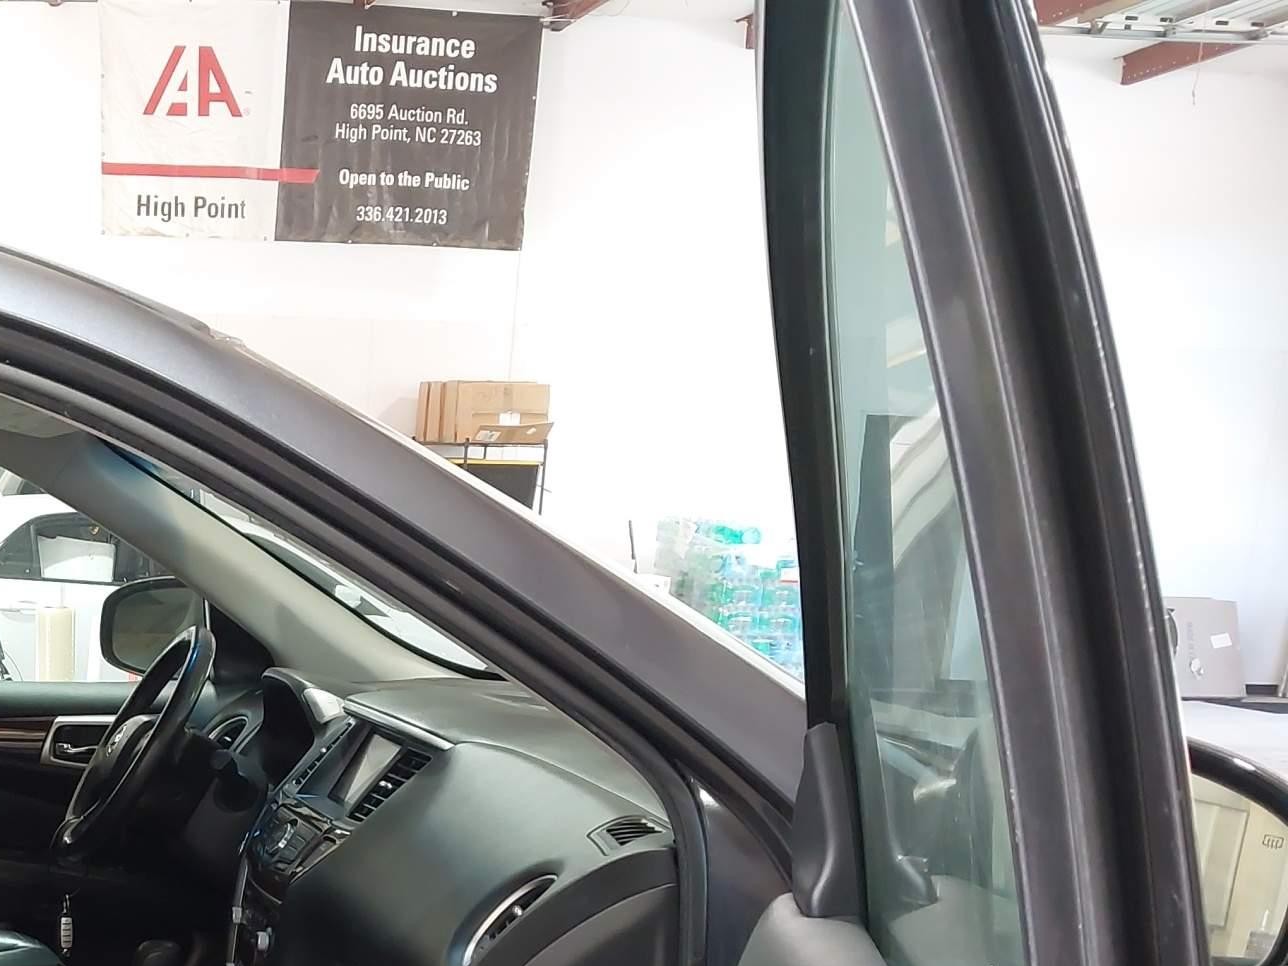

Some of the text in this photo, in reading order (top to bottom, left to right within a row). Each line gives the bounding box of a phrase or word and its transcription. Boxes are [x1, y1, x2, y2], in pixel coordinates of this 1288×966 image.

[354, 25, 476, 59] Insurance
[326, 57, 499, 93] Auto Auctions
[350, 103, 469, 125] 6695 Auction Rd.
[335, 122, 482, 147] High Point, NC 27263
[339, 168, 470, 191] Open to the Public
[136, 193, 247, 223] High Point
[356, 205, 448, 225] 336.421.2013
